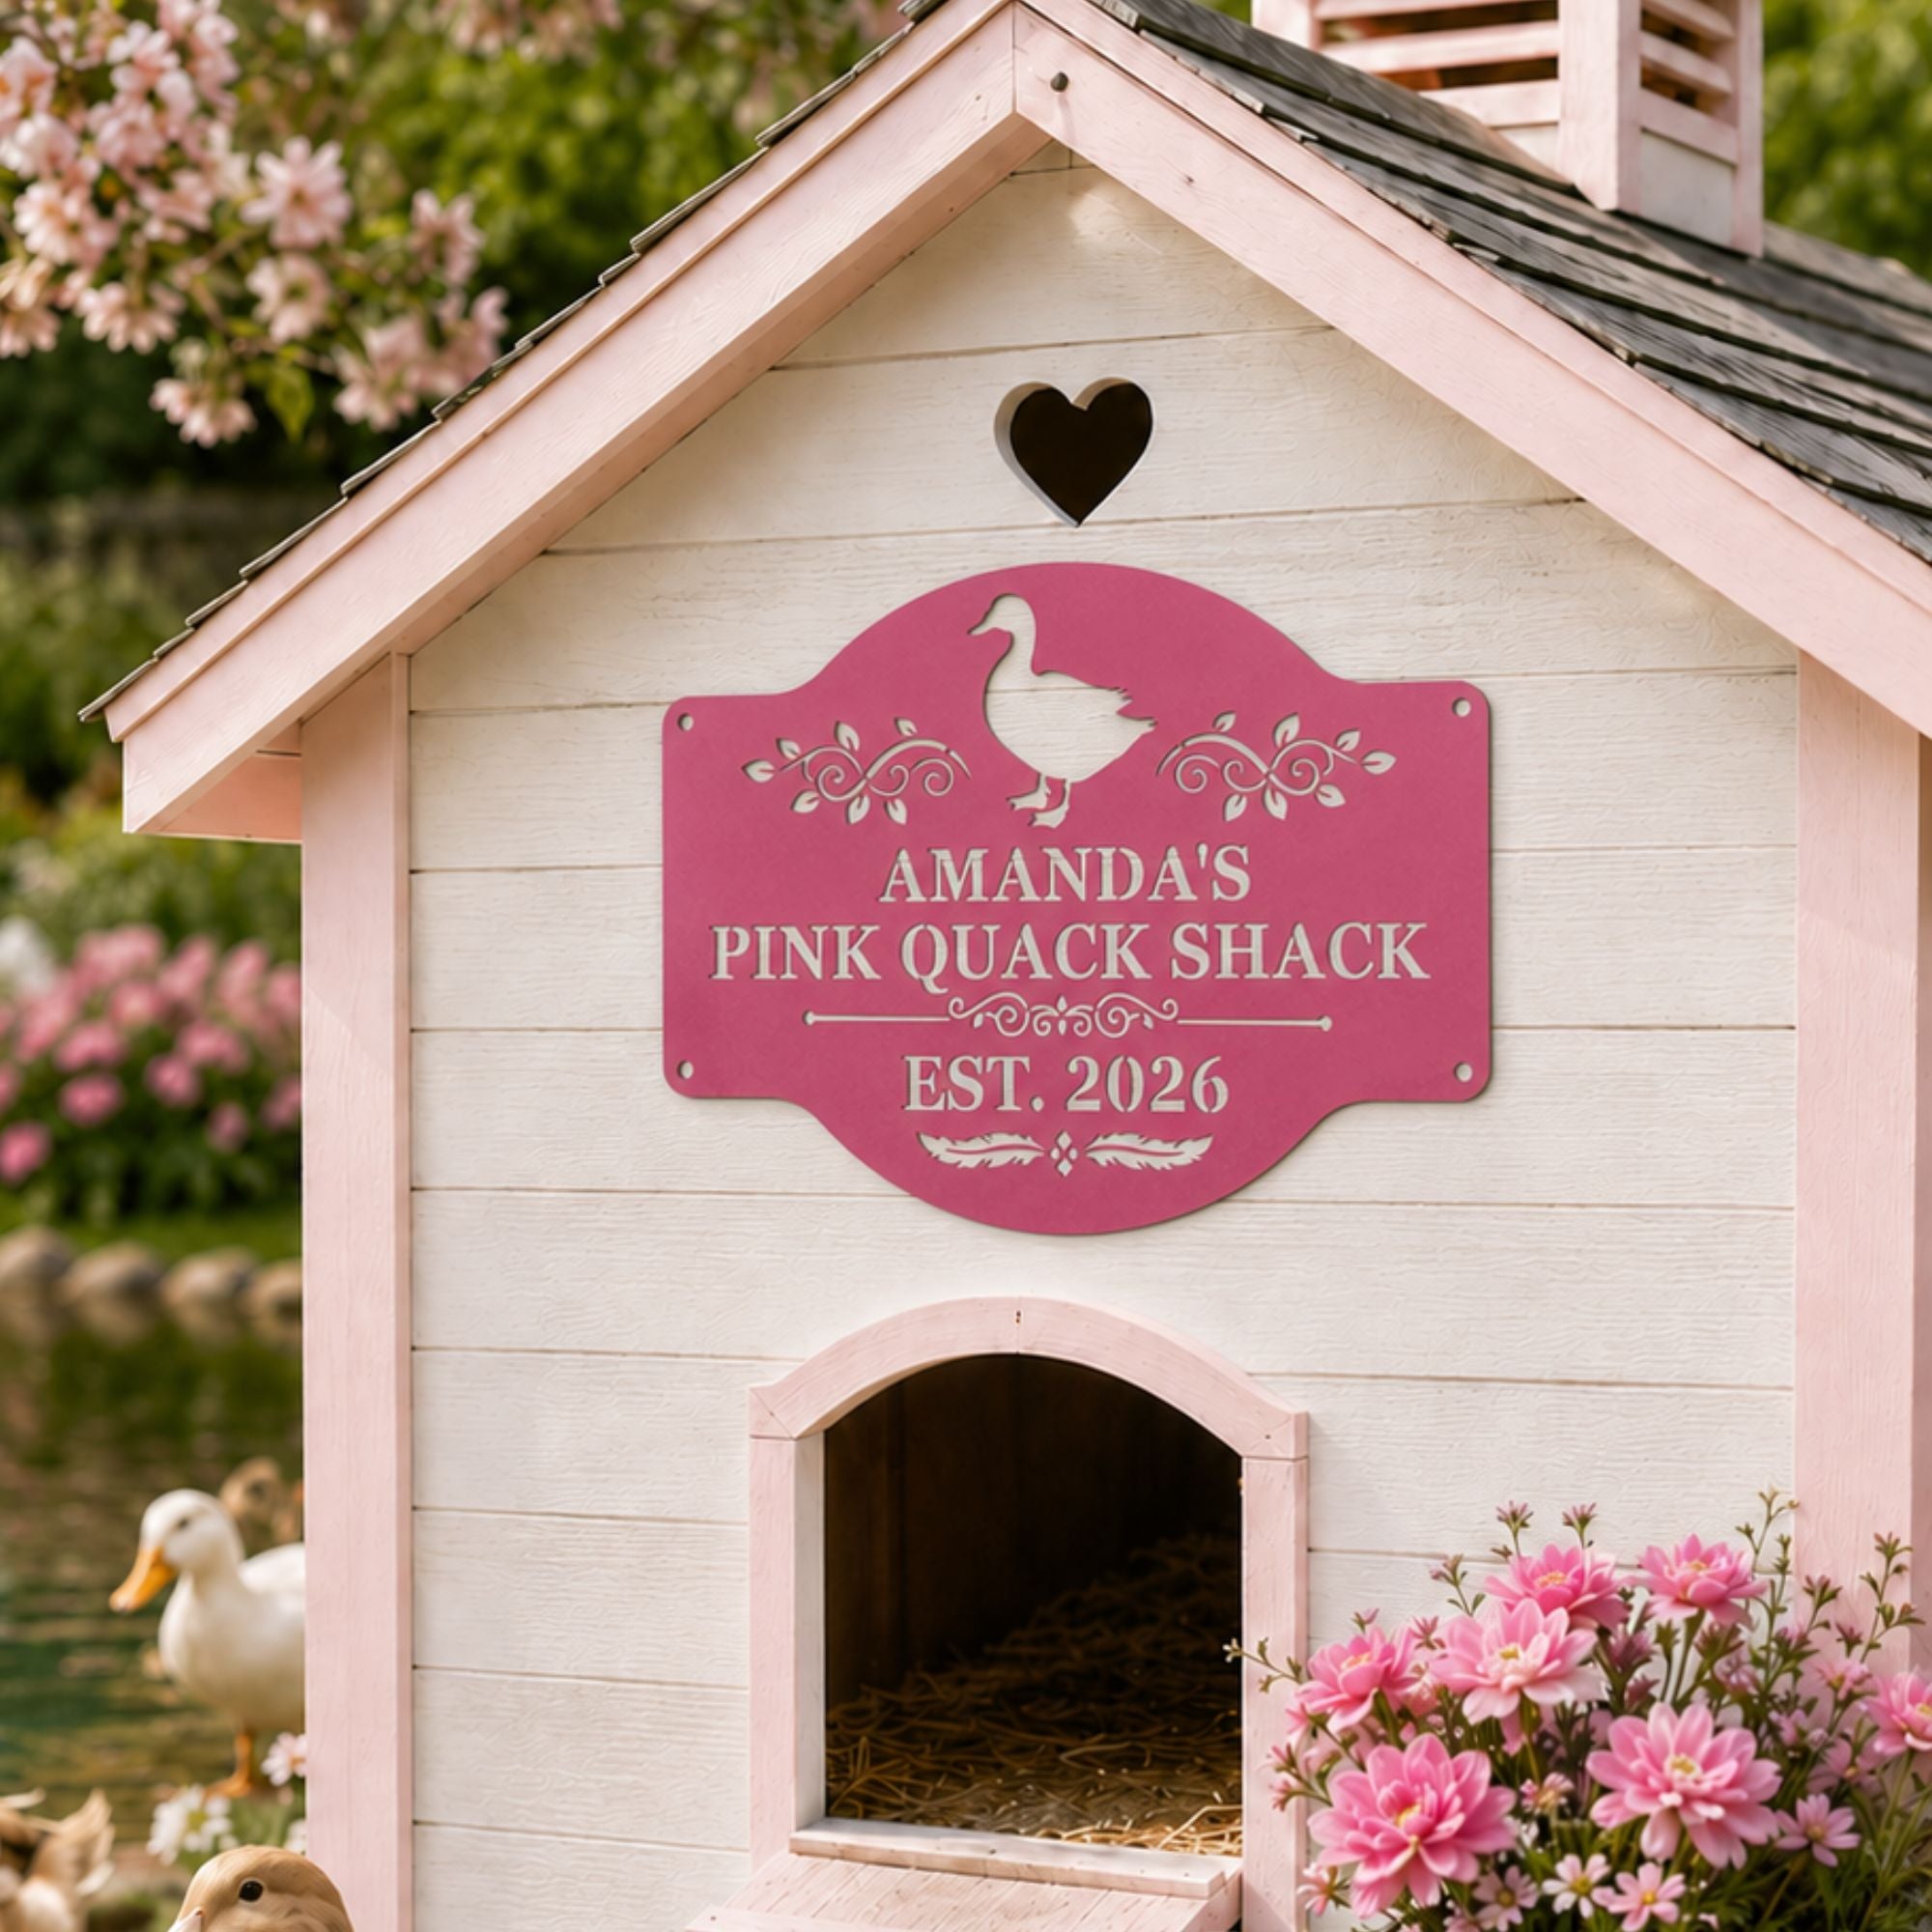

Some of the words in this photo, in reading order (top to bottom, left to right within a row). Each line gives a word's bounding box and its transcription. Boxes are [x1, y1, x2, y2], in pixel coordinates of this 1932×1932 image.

[879, 845, 1250, 903] AMANDA'S
[712, 924, 881, 980] PINK
[900, 923, 1151, 994] QUACK
[1171, 921, 1430, 980] SHACK
[904, 1055, 1043, 1112] EST.
[1065, 1055, 1229, 1113] 2026
